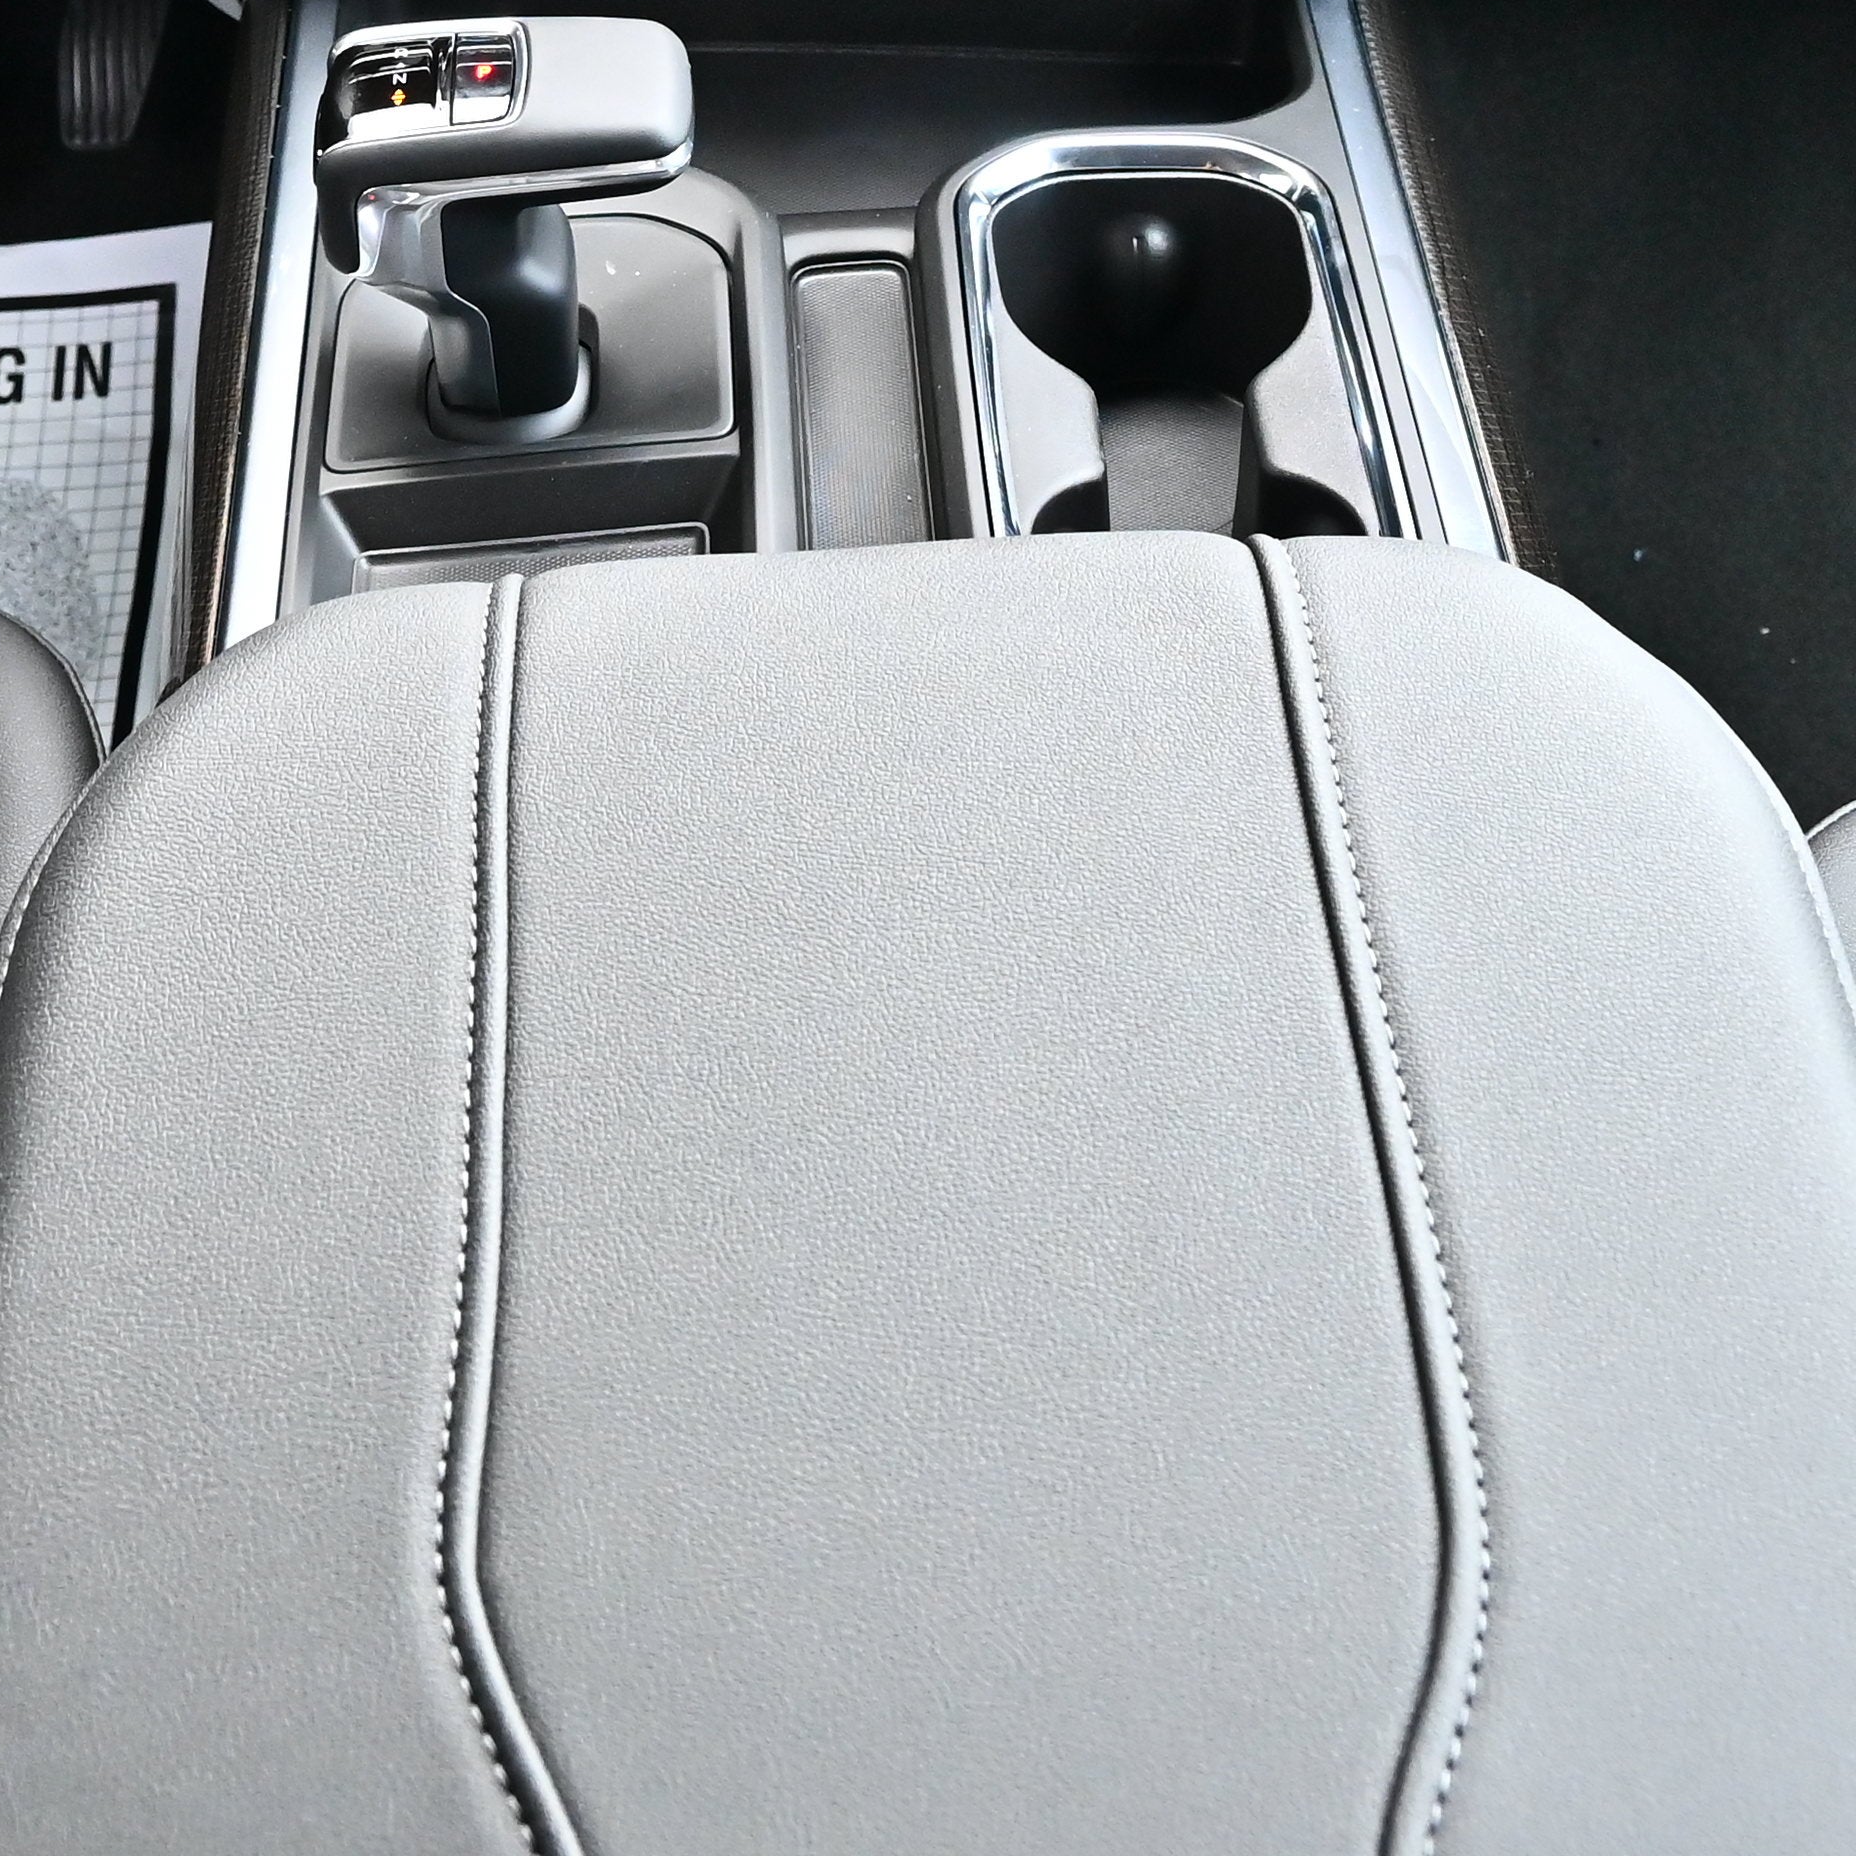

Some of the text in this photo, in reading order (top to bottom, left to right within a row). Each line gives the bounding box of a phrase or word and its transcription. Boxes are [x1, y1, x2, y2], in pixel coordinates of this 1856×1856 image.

[392, 72, 407, 85] N
[475, 64, 494, 80] P
[52, 341, 115, 401] IN
